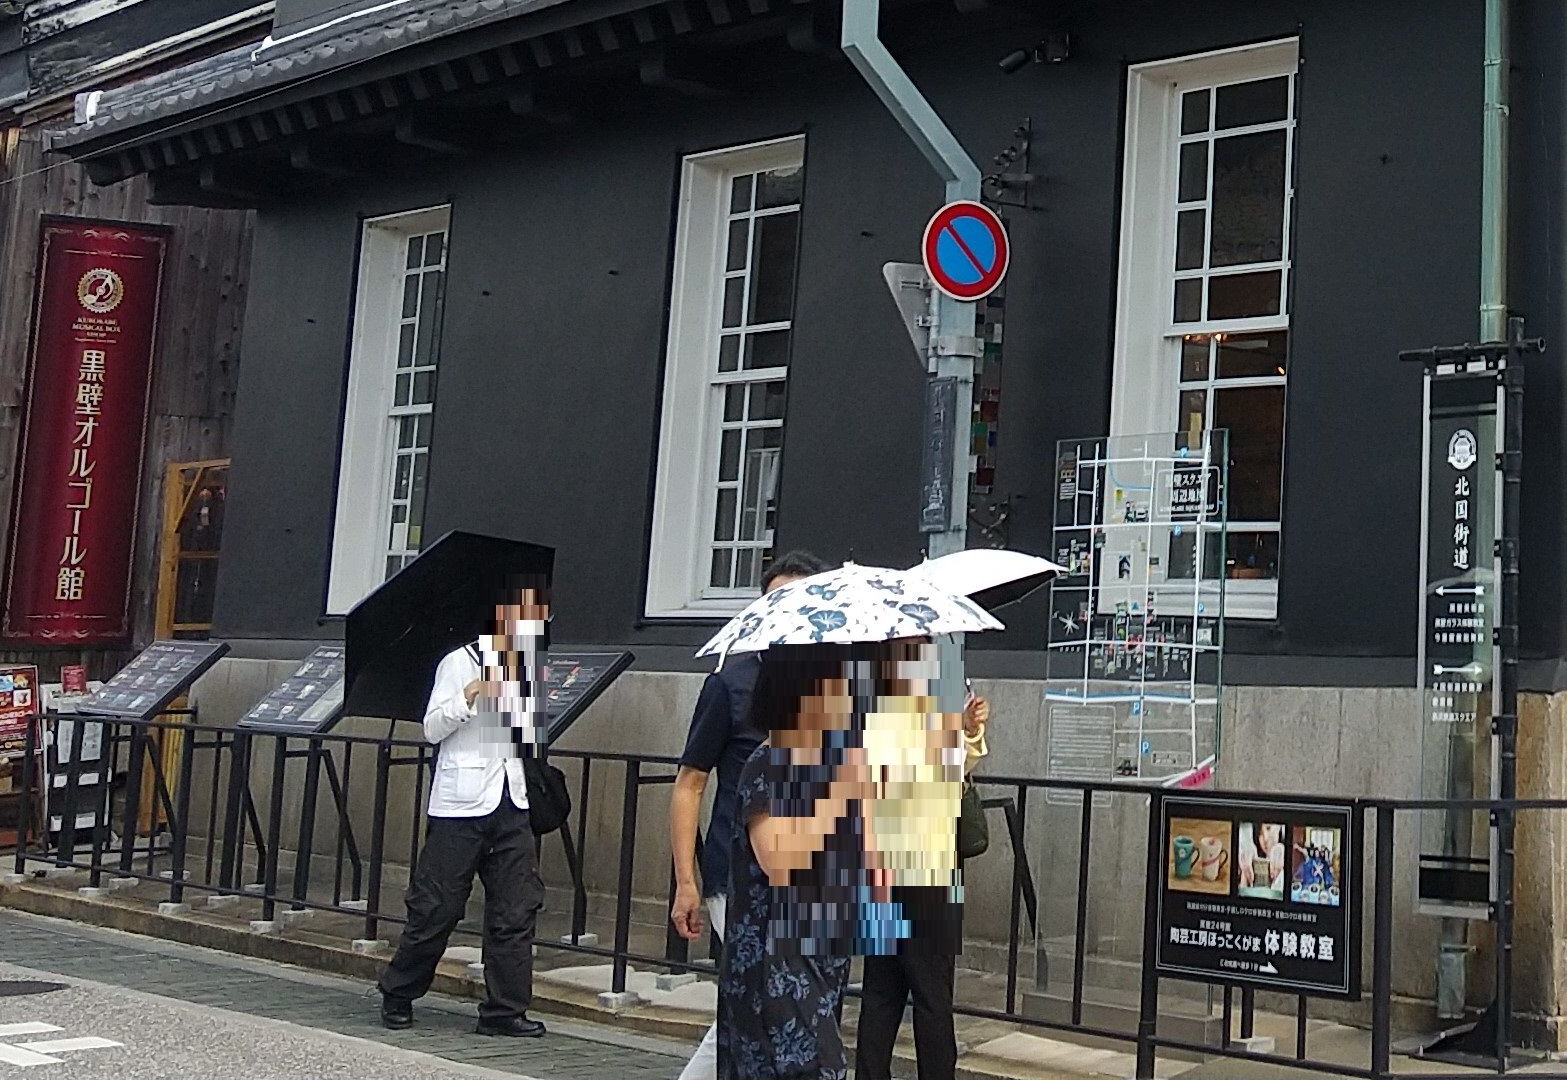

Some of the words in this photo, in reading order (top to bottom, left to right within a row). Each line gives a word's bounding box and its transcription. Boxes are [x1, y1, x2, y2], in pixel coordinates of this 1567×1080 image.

[55, 349, 106, 601] 黒壁オルゴール館
[1453, 475, 1470, 570] 北国街道
[1169, 926, 1262, 953] 陶芸工房ほっこくがま
[1264, 928, 1334, 961] 体験教室
